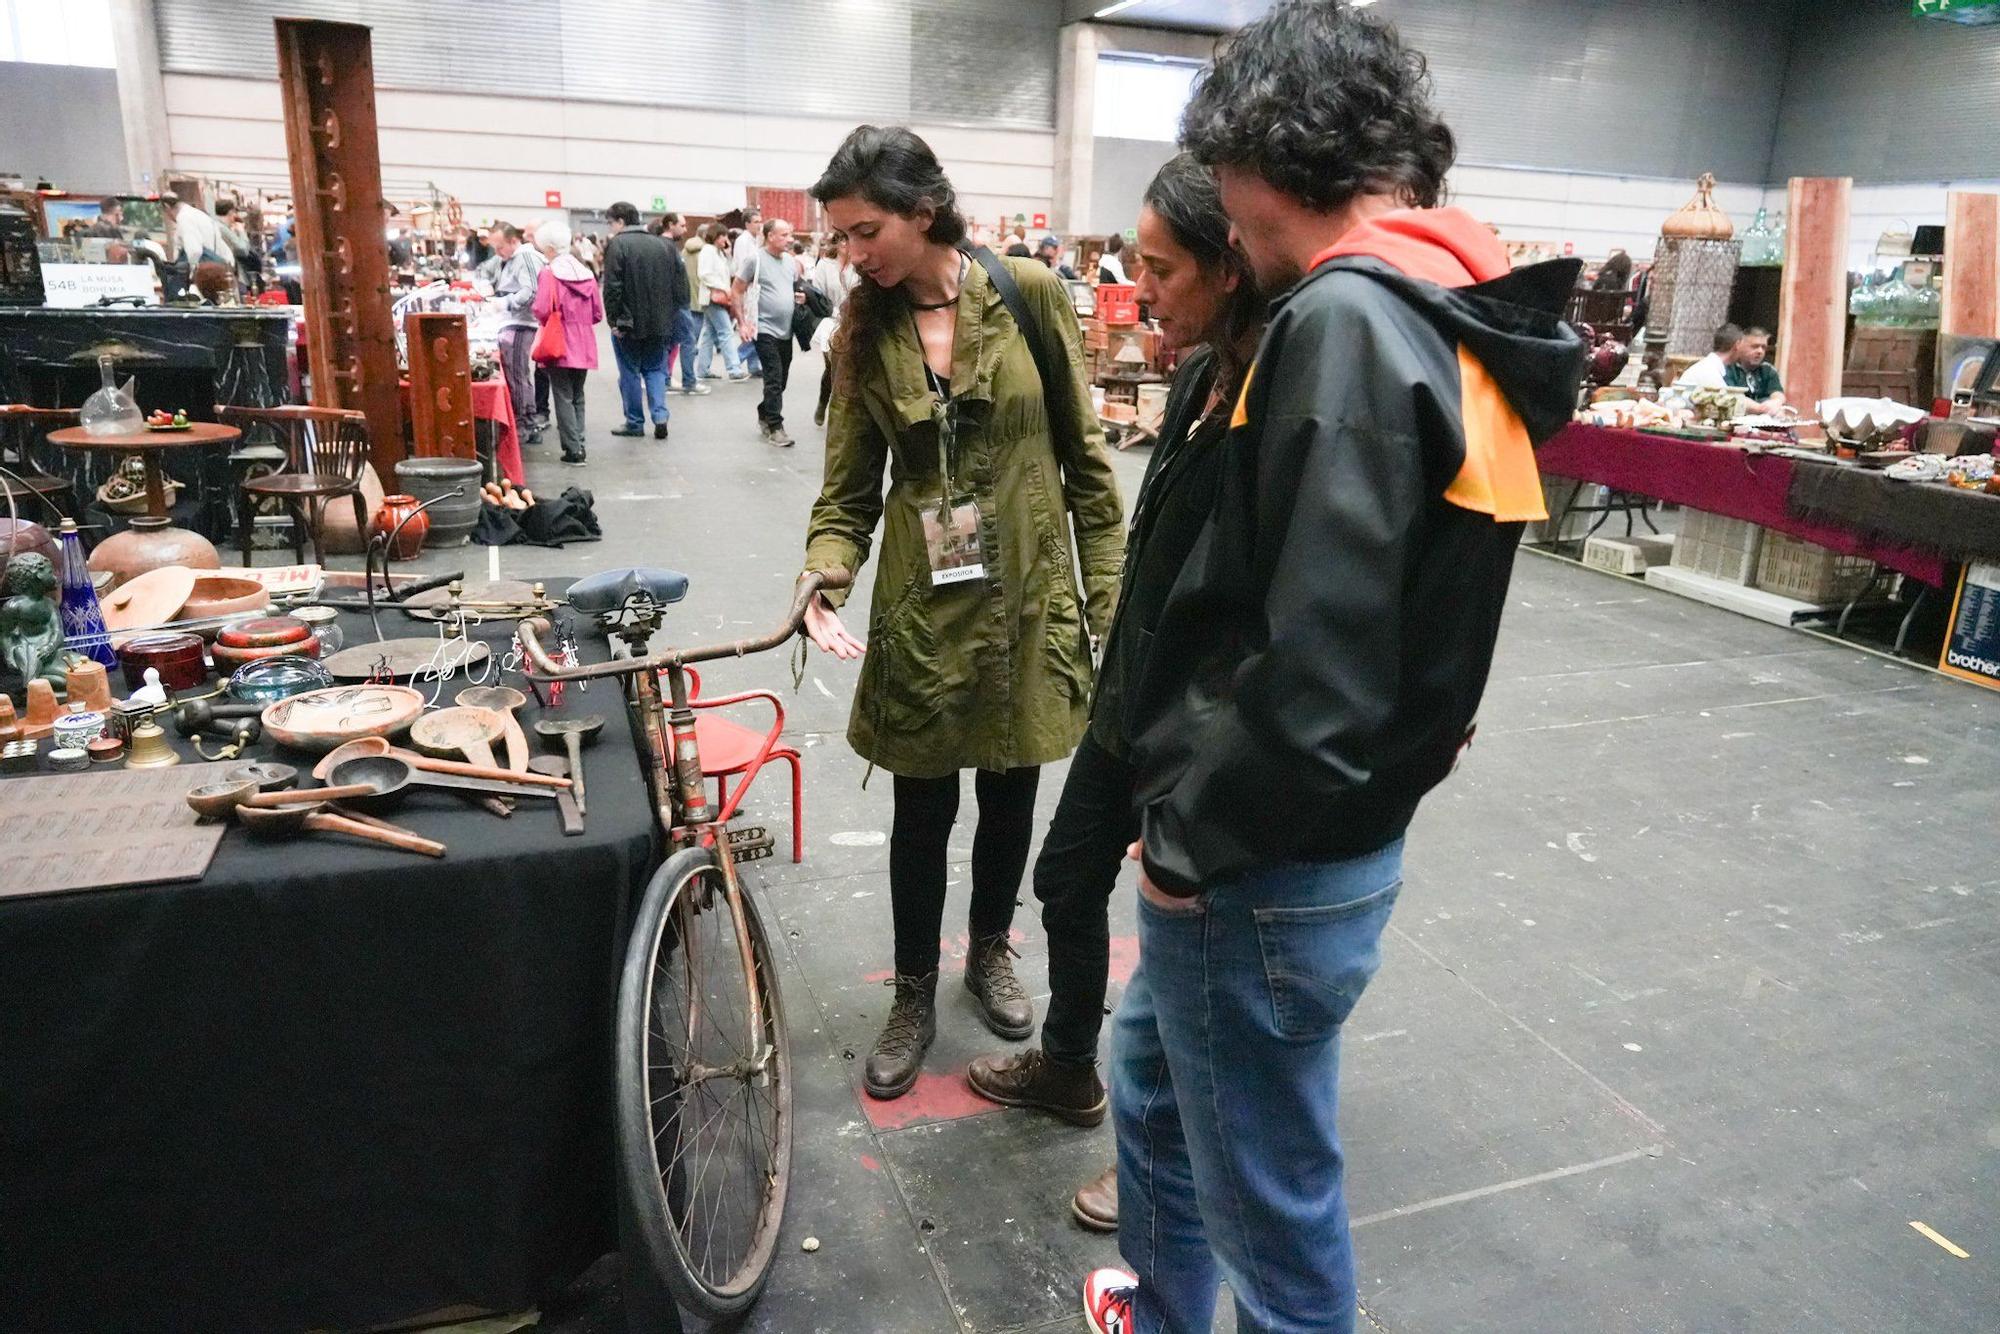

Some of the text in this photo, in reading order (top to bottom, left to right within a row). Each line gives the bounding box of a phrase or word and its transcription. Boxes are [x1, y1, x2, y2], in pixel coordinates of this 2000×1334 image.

[80, 274, 125, 283] LA MUSA
[81, 286, 126, 294] BOHEMIA
[941, 569, 973, 580] EXPOSITOR
[1948, 650, 2000, 676] brother
